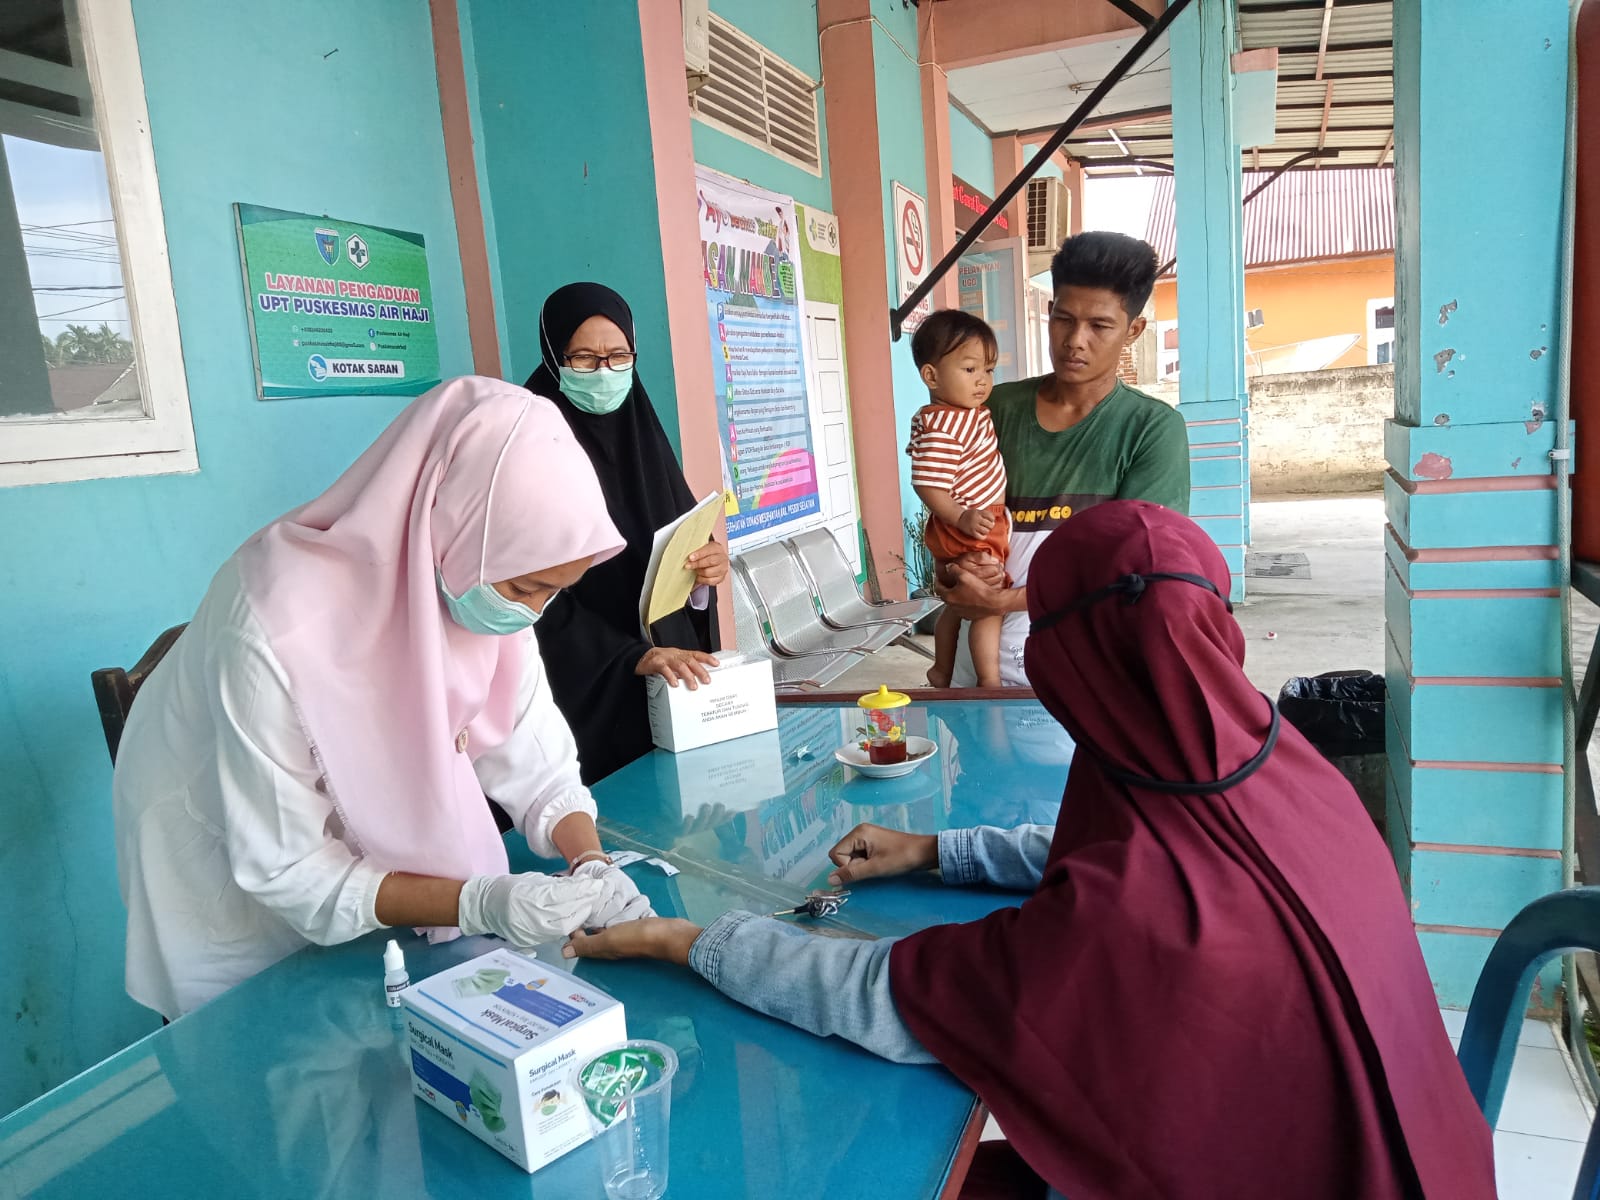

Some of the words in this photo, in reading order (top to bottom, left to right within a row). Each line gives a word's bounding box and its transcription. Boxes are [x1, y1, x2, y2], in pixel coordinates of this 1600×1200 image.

[739, 248, 781, 299] MANDE
[962, 277, 977, 287] UGD
[266, 273, 335, 295] LAYANAN
[339, 281, 420, 303] PENGADUAN
[259, 295, 289, 312] UPT
[294, 297, 376, 318] PUSKESMAS
[379, 306, 399, 320] AIR
[402, 308, 430, 322] HAJI
[332, 362, 365, 374] KOTAK
[368, 363, 398, 374] SARAN
[1049, 505, 1072, 519] GO
[480, 1008, 505, 1025] Mask
[408, 1021, 434, 1049] Surgical
[434, 1039, 454, 1060] Mask
[499, 1018, 539, 1040] Surgical
[529, 1057, 557, 1078] Surgical
[557, 1048, 576, 1063] Mask
